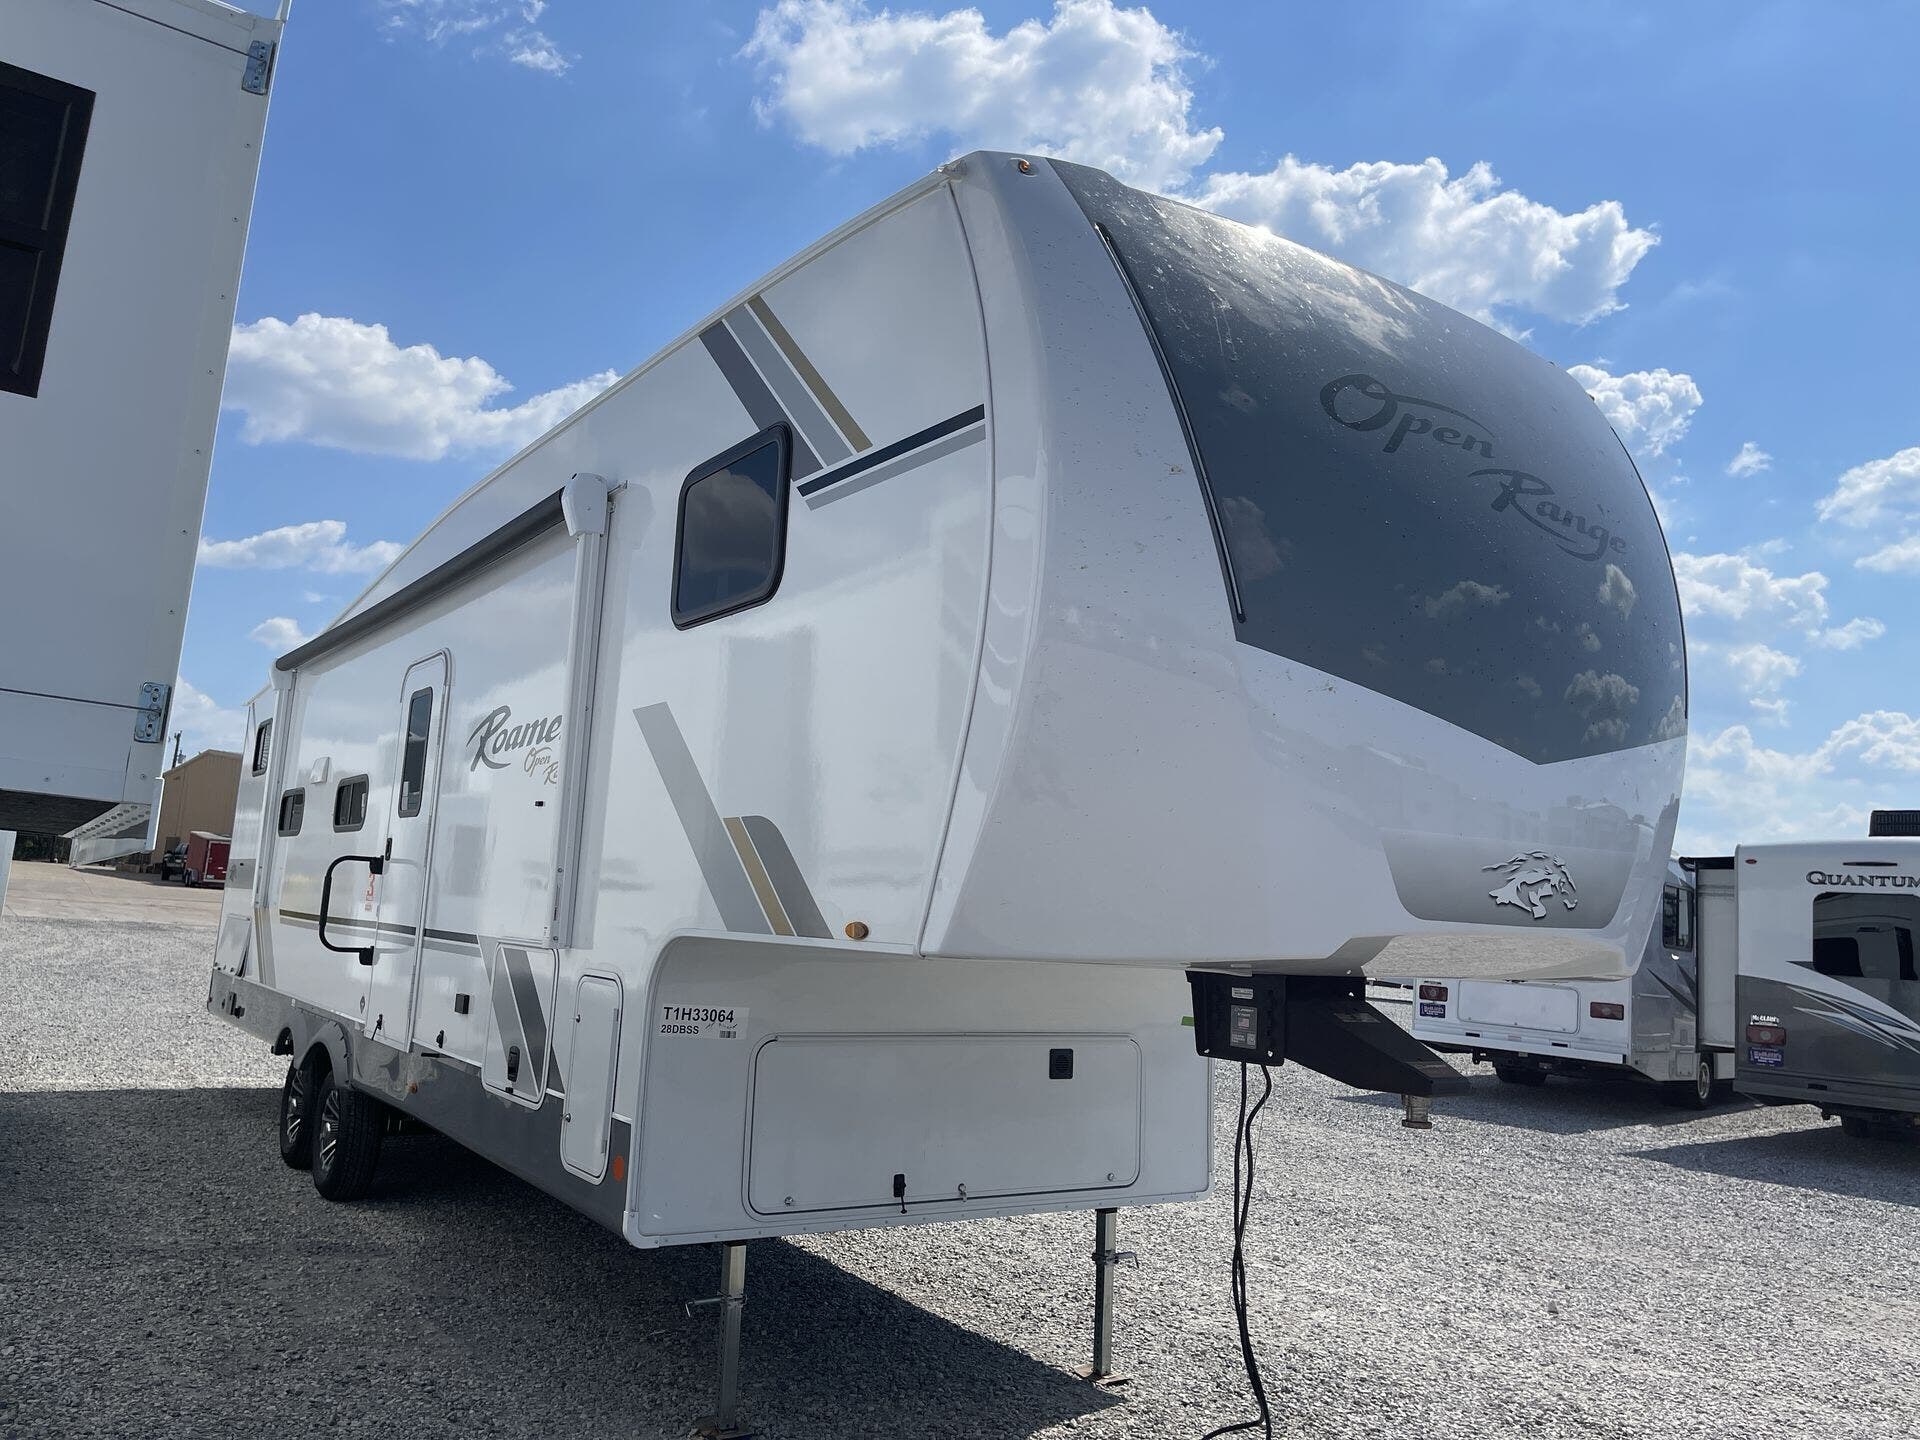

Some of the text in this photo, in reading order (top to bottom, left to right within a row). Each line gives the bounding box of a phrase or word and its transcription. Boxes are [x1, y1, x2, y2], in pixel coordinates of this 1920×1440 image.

[1319, 373, 1496, 459] Open
[1467, 468, 1627, 561] Range
[465, 705, 562, 772] Roame
[524, 747, 553, 778] Open
[660, 1024, 699, 1035] 28DBSS
[663, 1006, 735, 1023] T1H33064
